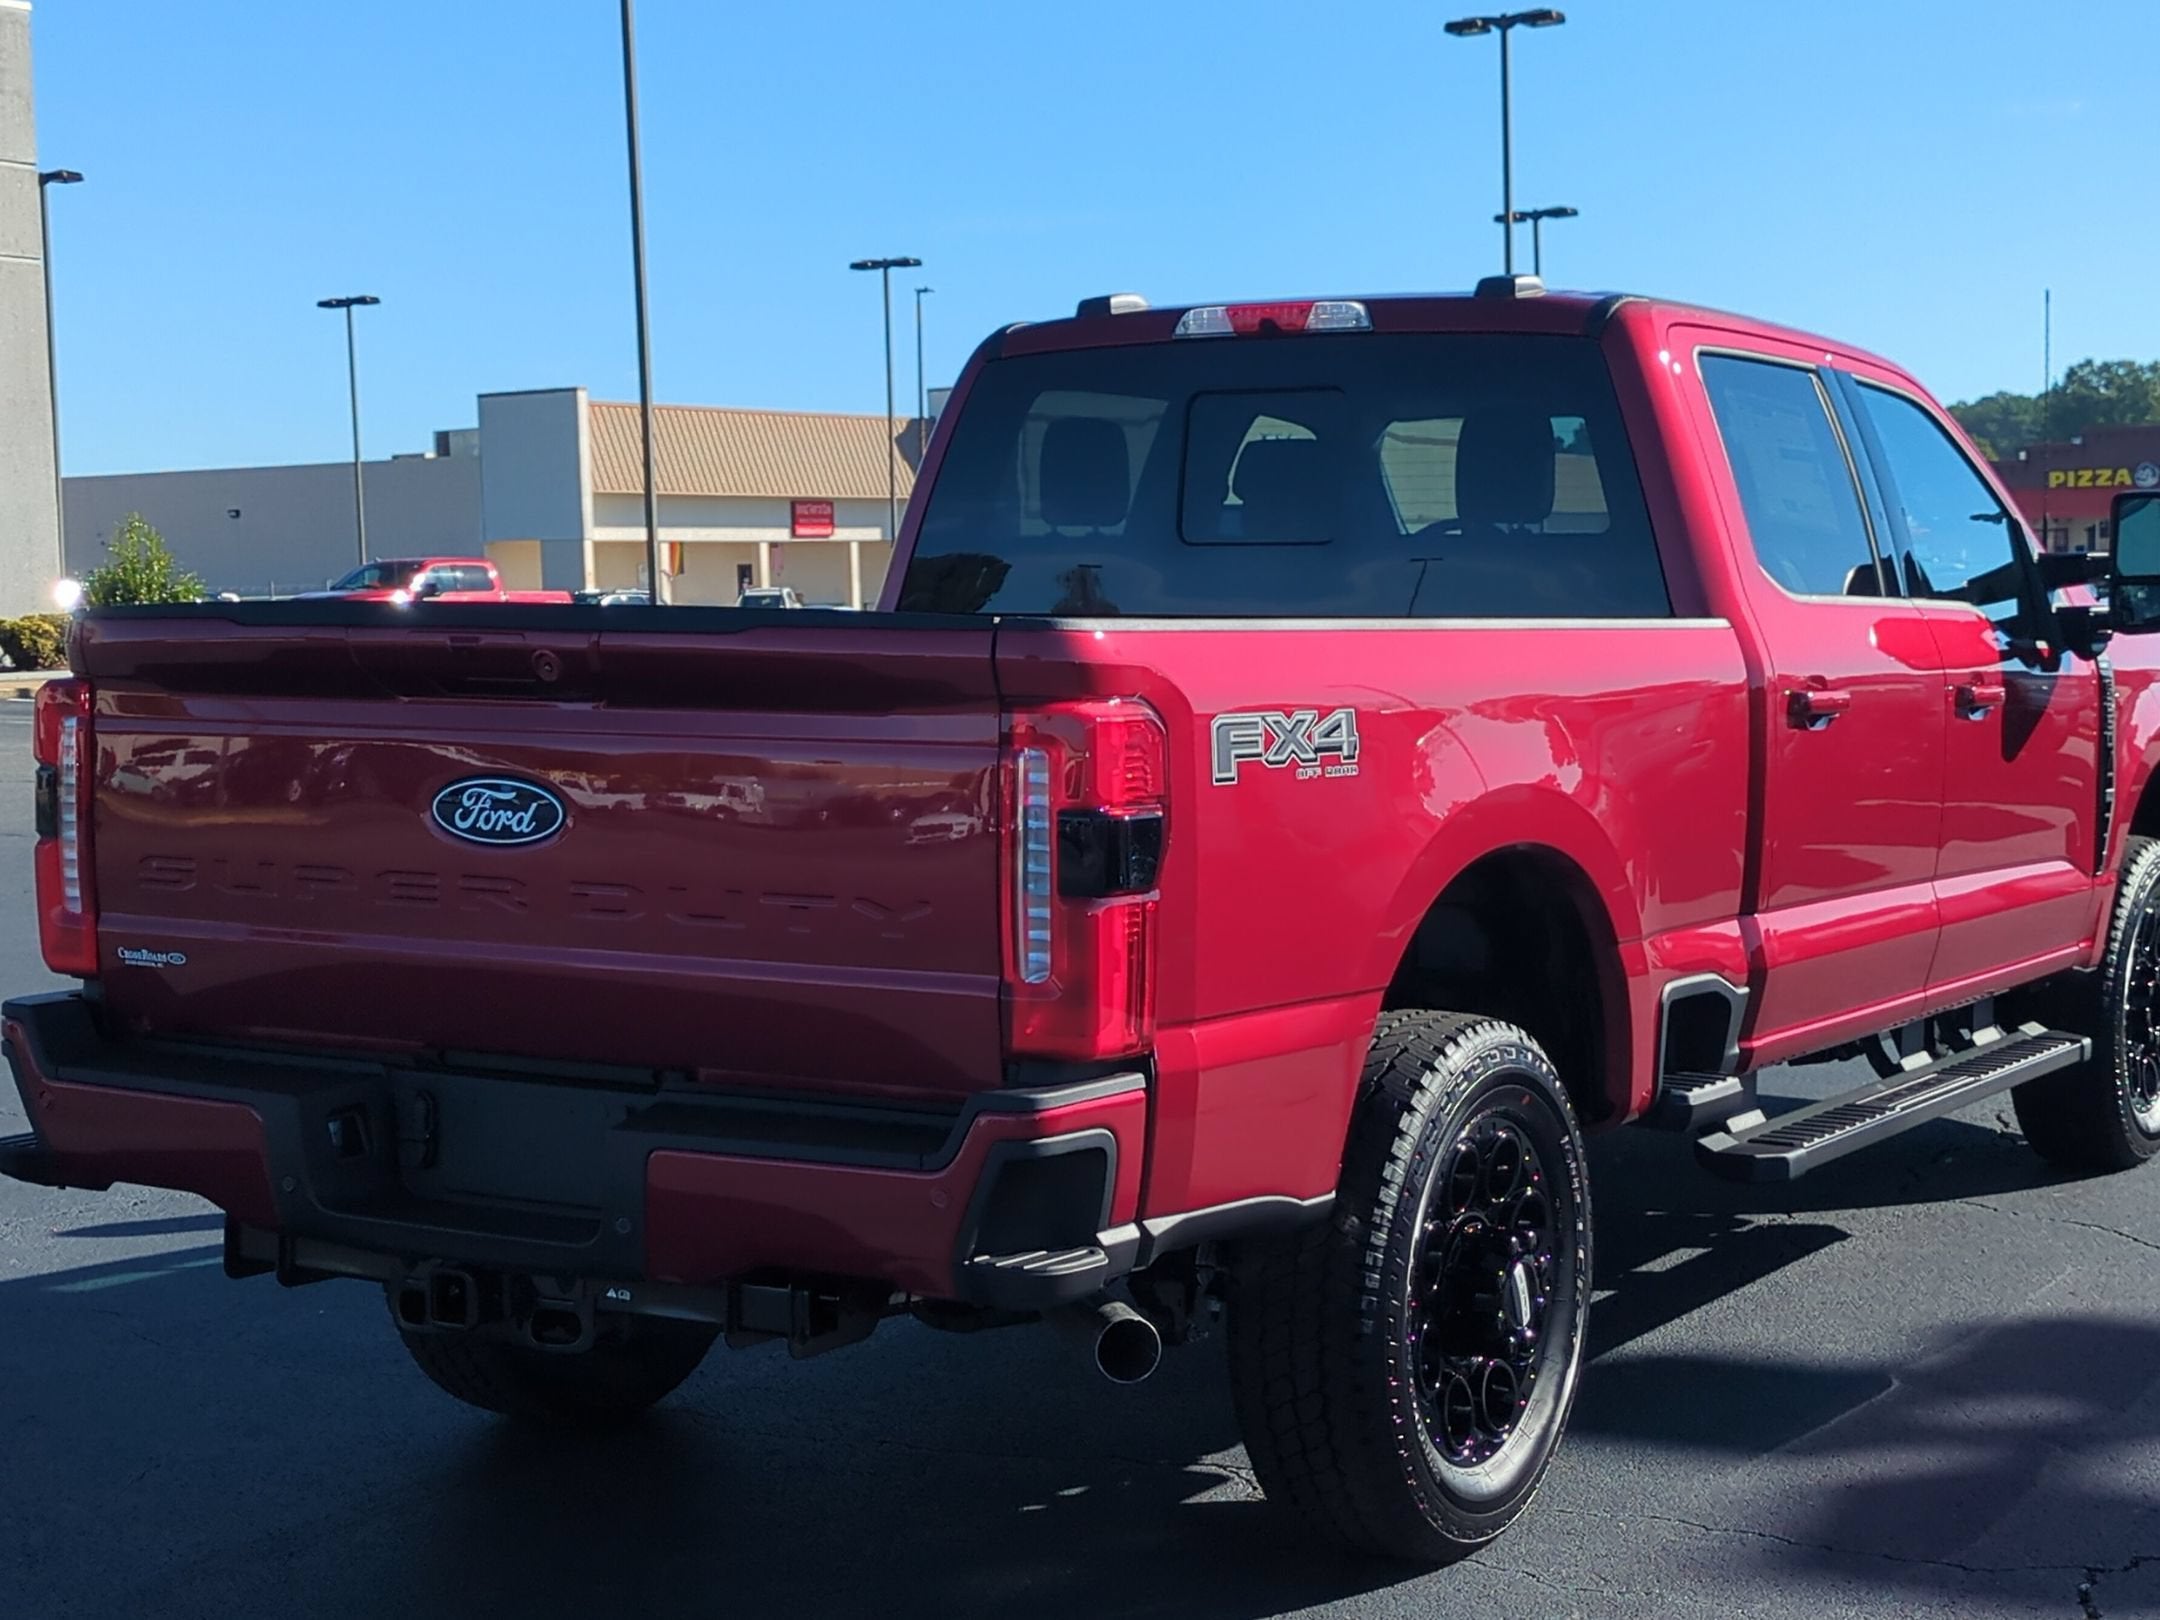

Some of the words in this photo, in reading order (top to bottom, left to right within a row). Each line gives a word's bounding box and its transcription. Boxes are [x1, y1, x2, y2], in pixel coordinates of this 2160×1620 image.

[2048, 468, 2132, 488] PIZZA
[1211, 709, 1359, 786] FX4
[454, 787, 538, 833] Ford
[138, 855, 529, 914] SUPER
[569, 880, 933, 938] DUTY
